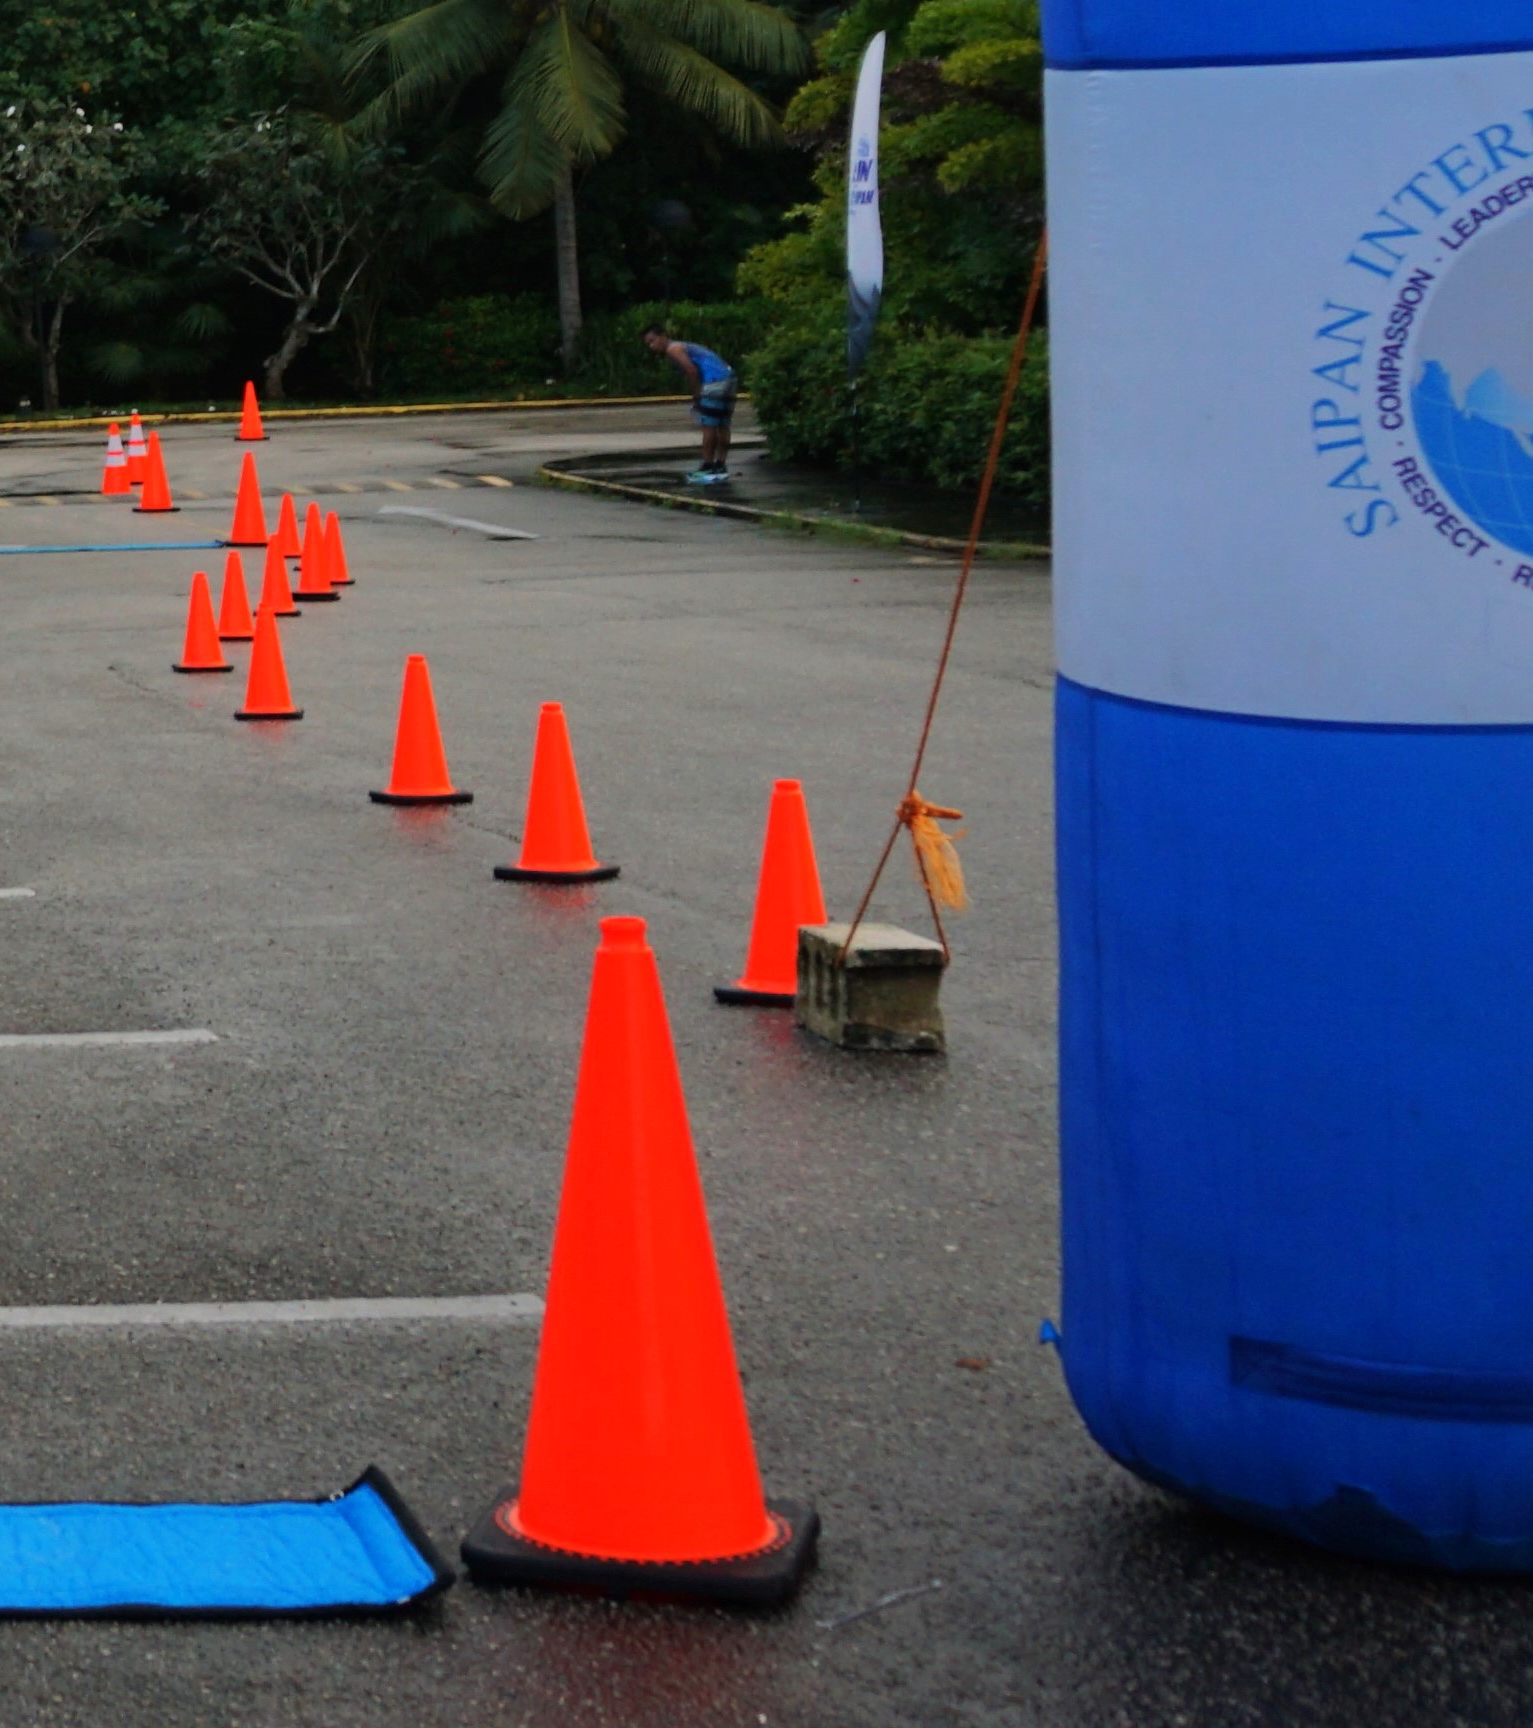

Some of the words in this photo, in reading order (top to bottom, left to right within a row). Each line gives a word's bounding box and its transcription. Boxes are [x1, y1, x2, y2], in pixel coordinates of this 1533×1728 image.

[1345, 107, 1533, 280] INTER
[1311, 299, 1401, 539] SAIPAN
[1376, 268, 1435, 432] COMPASSION
[1392, 455, 1490, 558] RESPECT
